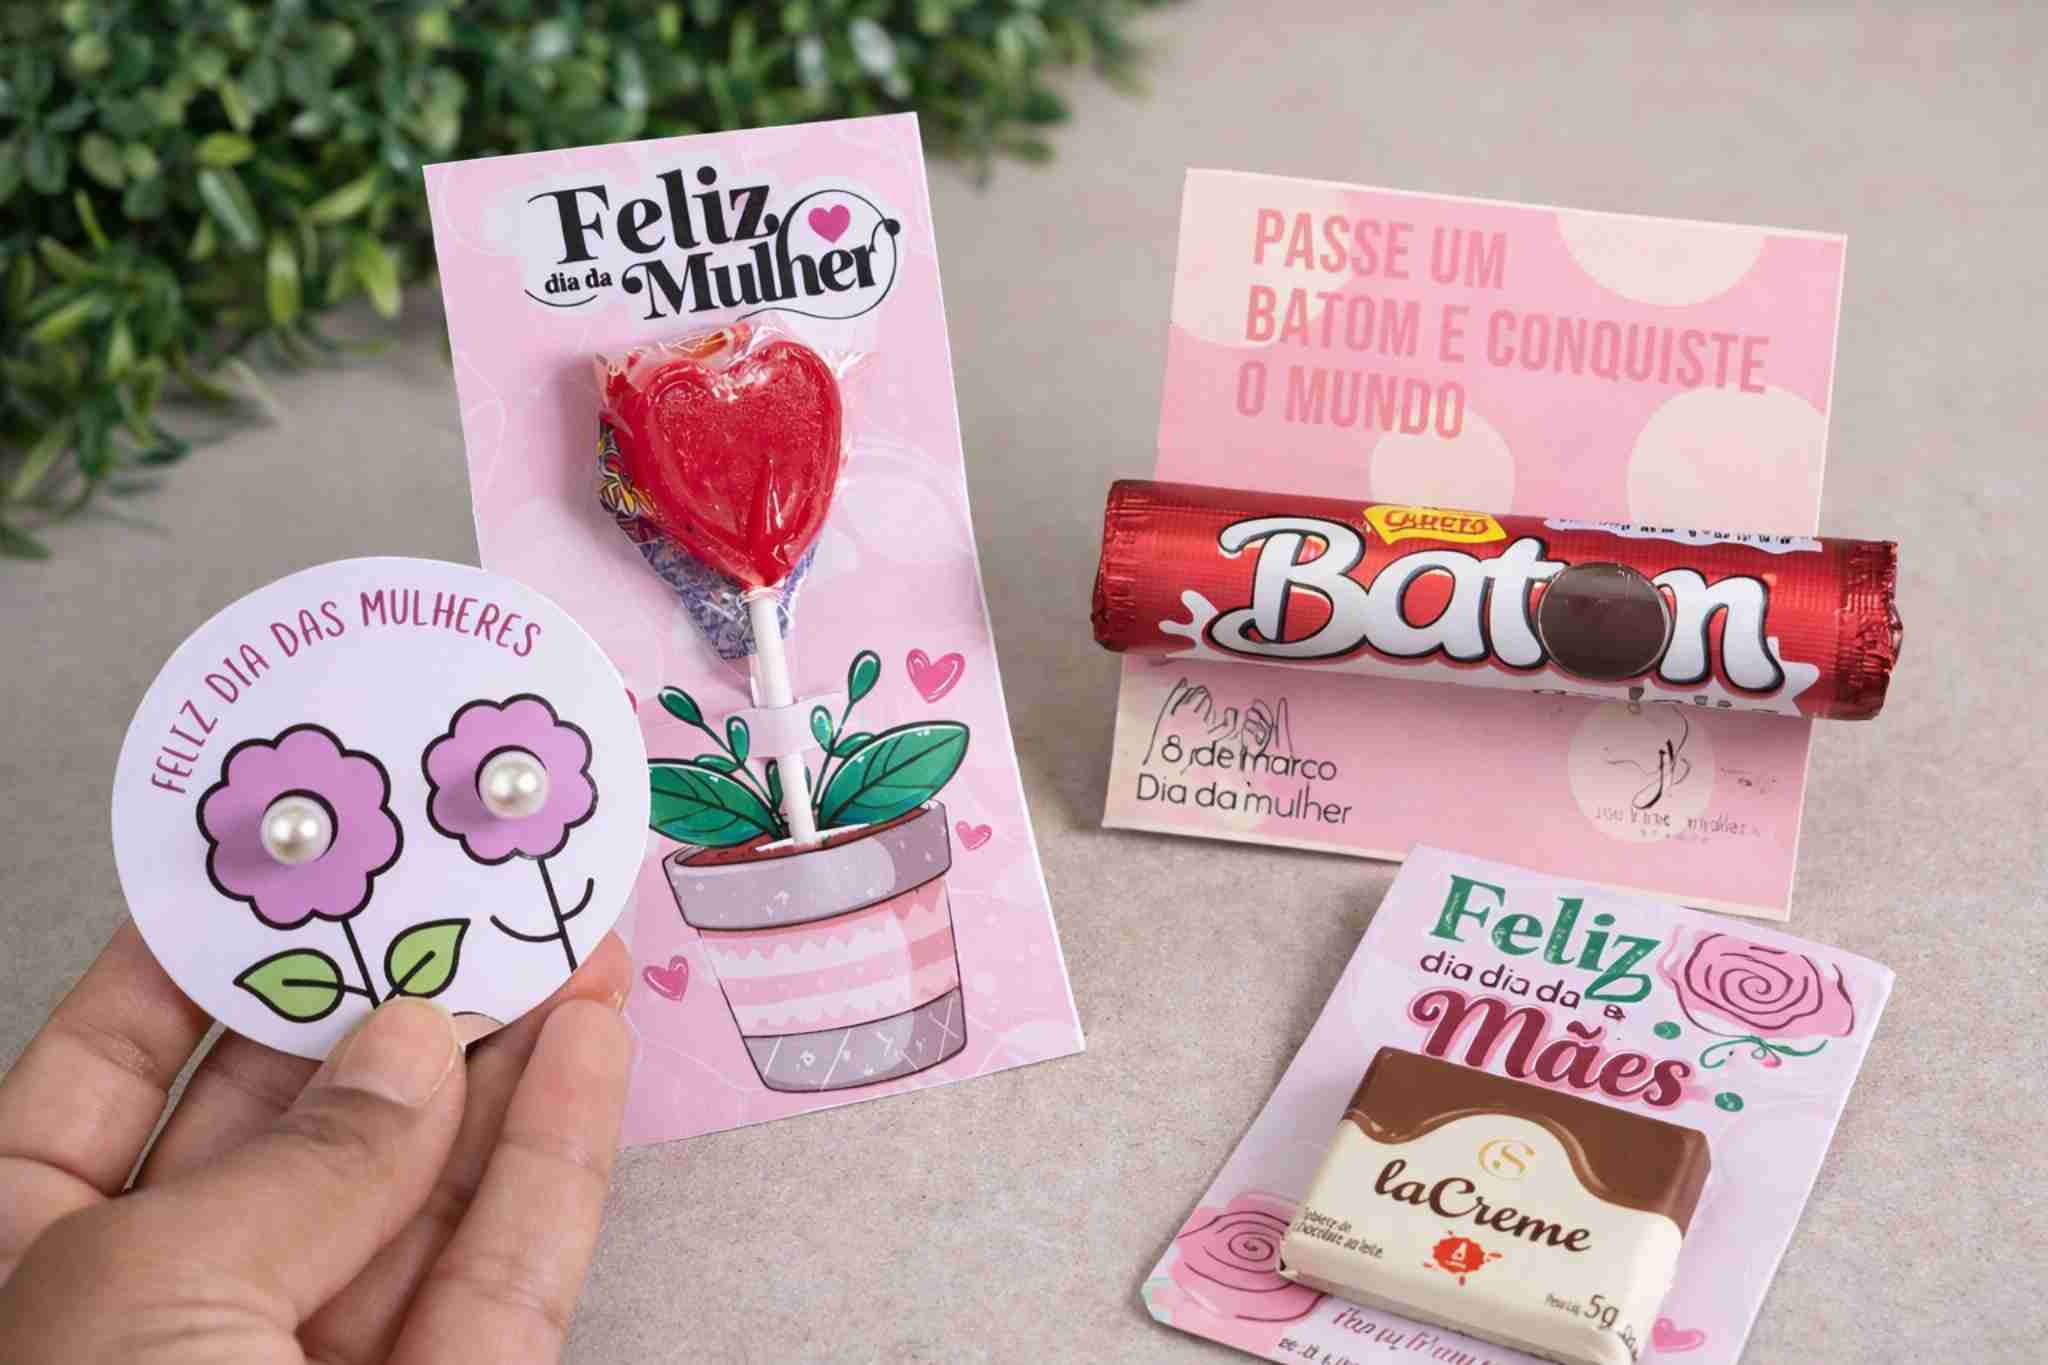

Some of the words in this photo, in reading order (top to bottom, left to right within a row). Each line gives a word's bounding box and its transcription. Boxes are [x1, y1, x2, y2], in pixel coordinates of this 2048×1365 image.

[528, 166, 779, 265] Feliz
[622, 190, 900, 321] Mulher
[1252, 208, 1414, 279] PASSE
[1430, 227, 1507, 289] UM
[545, 272, 580, 294] dia
[585, 268, 612, 289] da
[1244, 285, 1421, 358] BATOM
[1439, 304, 1471, 363] E
[1487, 309, 1770, 395] CONQUISTE
[1236, 360, 1267, 417] O
[1285, 364, 1465, 440] MUNDO
[151, 699, 219, 794] FELIZ
[204, 643, 270, 704] DIA
[270, 600, 345, 658] DAS
[360, 588, 542, 657] MULHERES
[1161, 734, 1183, 763] 8
[1194, 741, 1235, 769] de
[1136, 773, 1187, 804] Dia
[1195, 782, 1237, 810] da
[1243, 784, 1353, 825] mulher
[1420, 951, 1471, 982] dia
[1479, 958, 1531, 997] dia
[1535, 979, 1582, 1010] da
[1429, 874, 1662, 1003] Feliz
[1410, 989, 1692, 1108] Mães
[1374, 1158, 1593, 1254] laCreme
[1583, 1293, 1620, 1330] 5g
